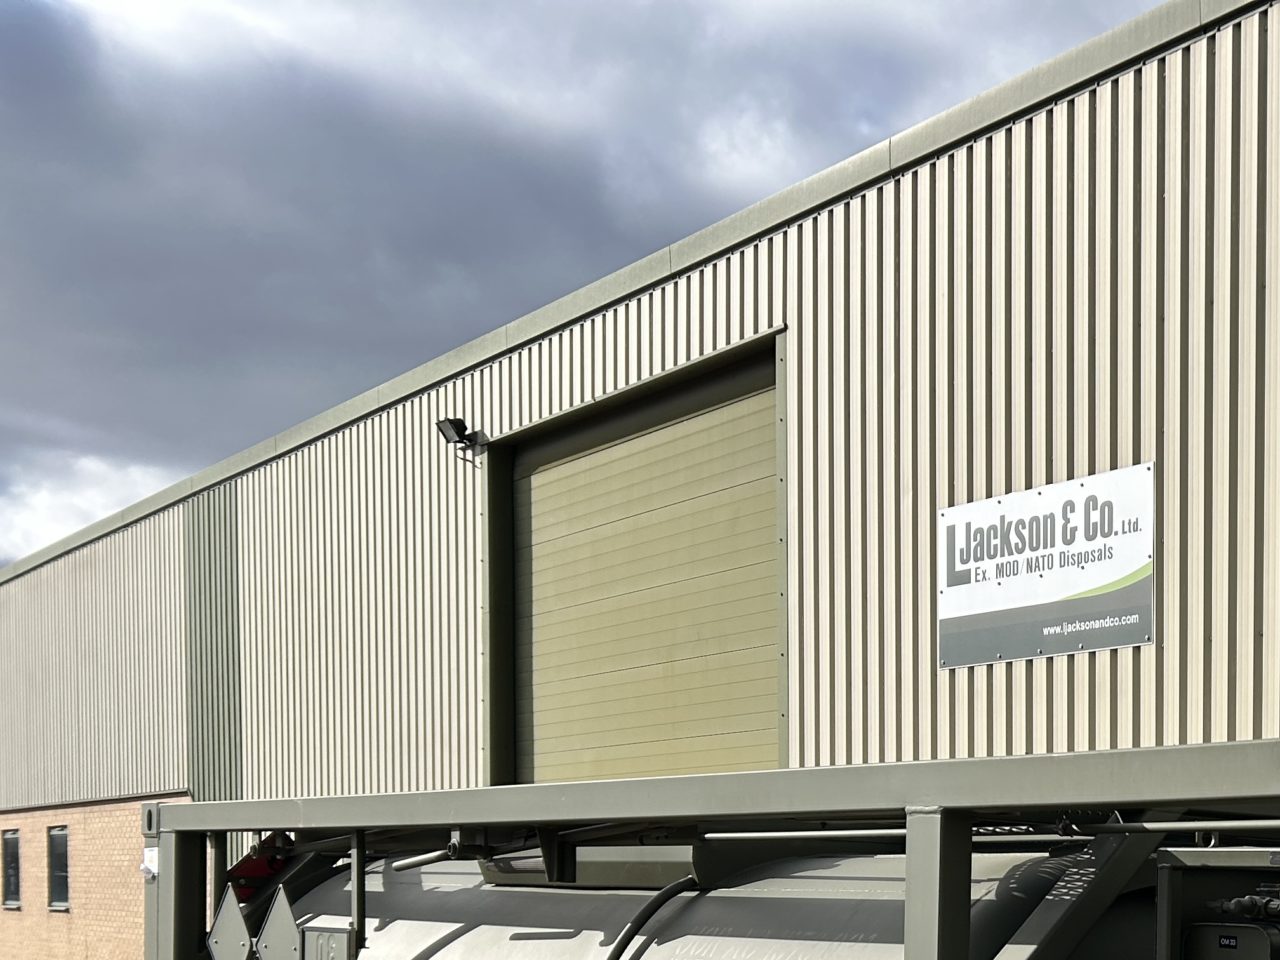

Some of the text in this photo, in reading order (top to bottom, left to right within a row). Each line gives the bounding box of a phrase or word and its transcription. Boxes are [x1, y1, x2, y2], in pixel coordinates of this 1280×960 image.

[1061, 499, 1078, 546] &
[1083, 495, 1118, 541] Co.
[1122, 517, 1142, 535] Ltd.
[974, 543, 1113, 583] Ex. MOD/NATO Disposals
[1043, 613, 1139, 636] www.ljacksonandco.com
